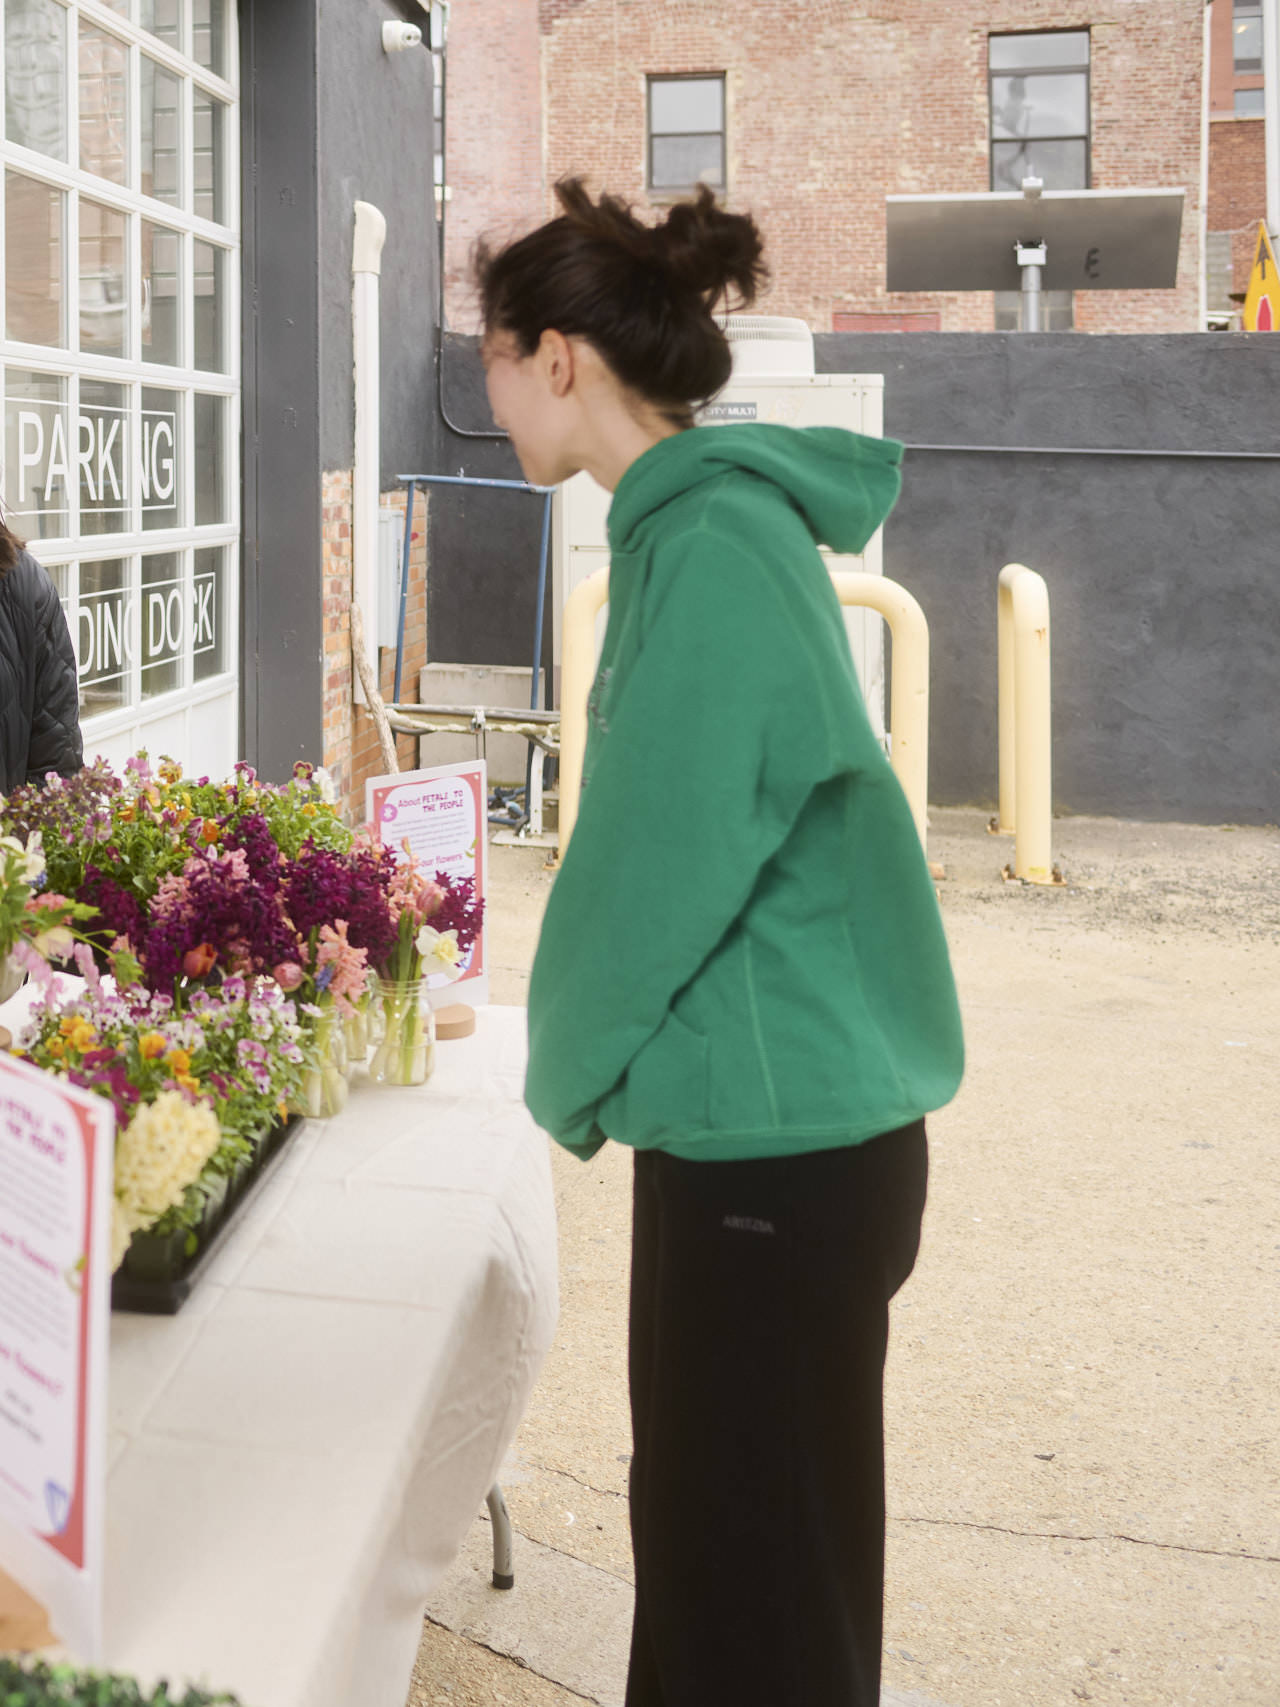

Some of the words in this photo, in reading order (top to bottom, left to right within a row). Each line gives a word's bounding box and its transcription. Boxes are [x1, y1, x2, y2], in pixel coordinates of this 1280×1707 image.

[727, 406, 756, 416] MULTI
[423, 804, 436, 812] THE
[439, 800, 464, 811] PEOPLE
[436, 853, 463, 864] flowers
